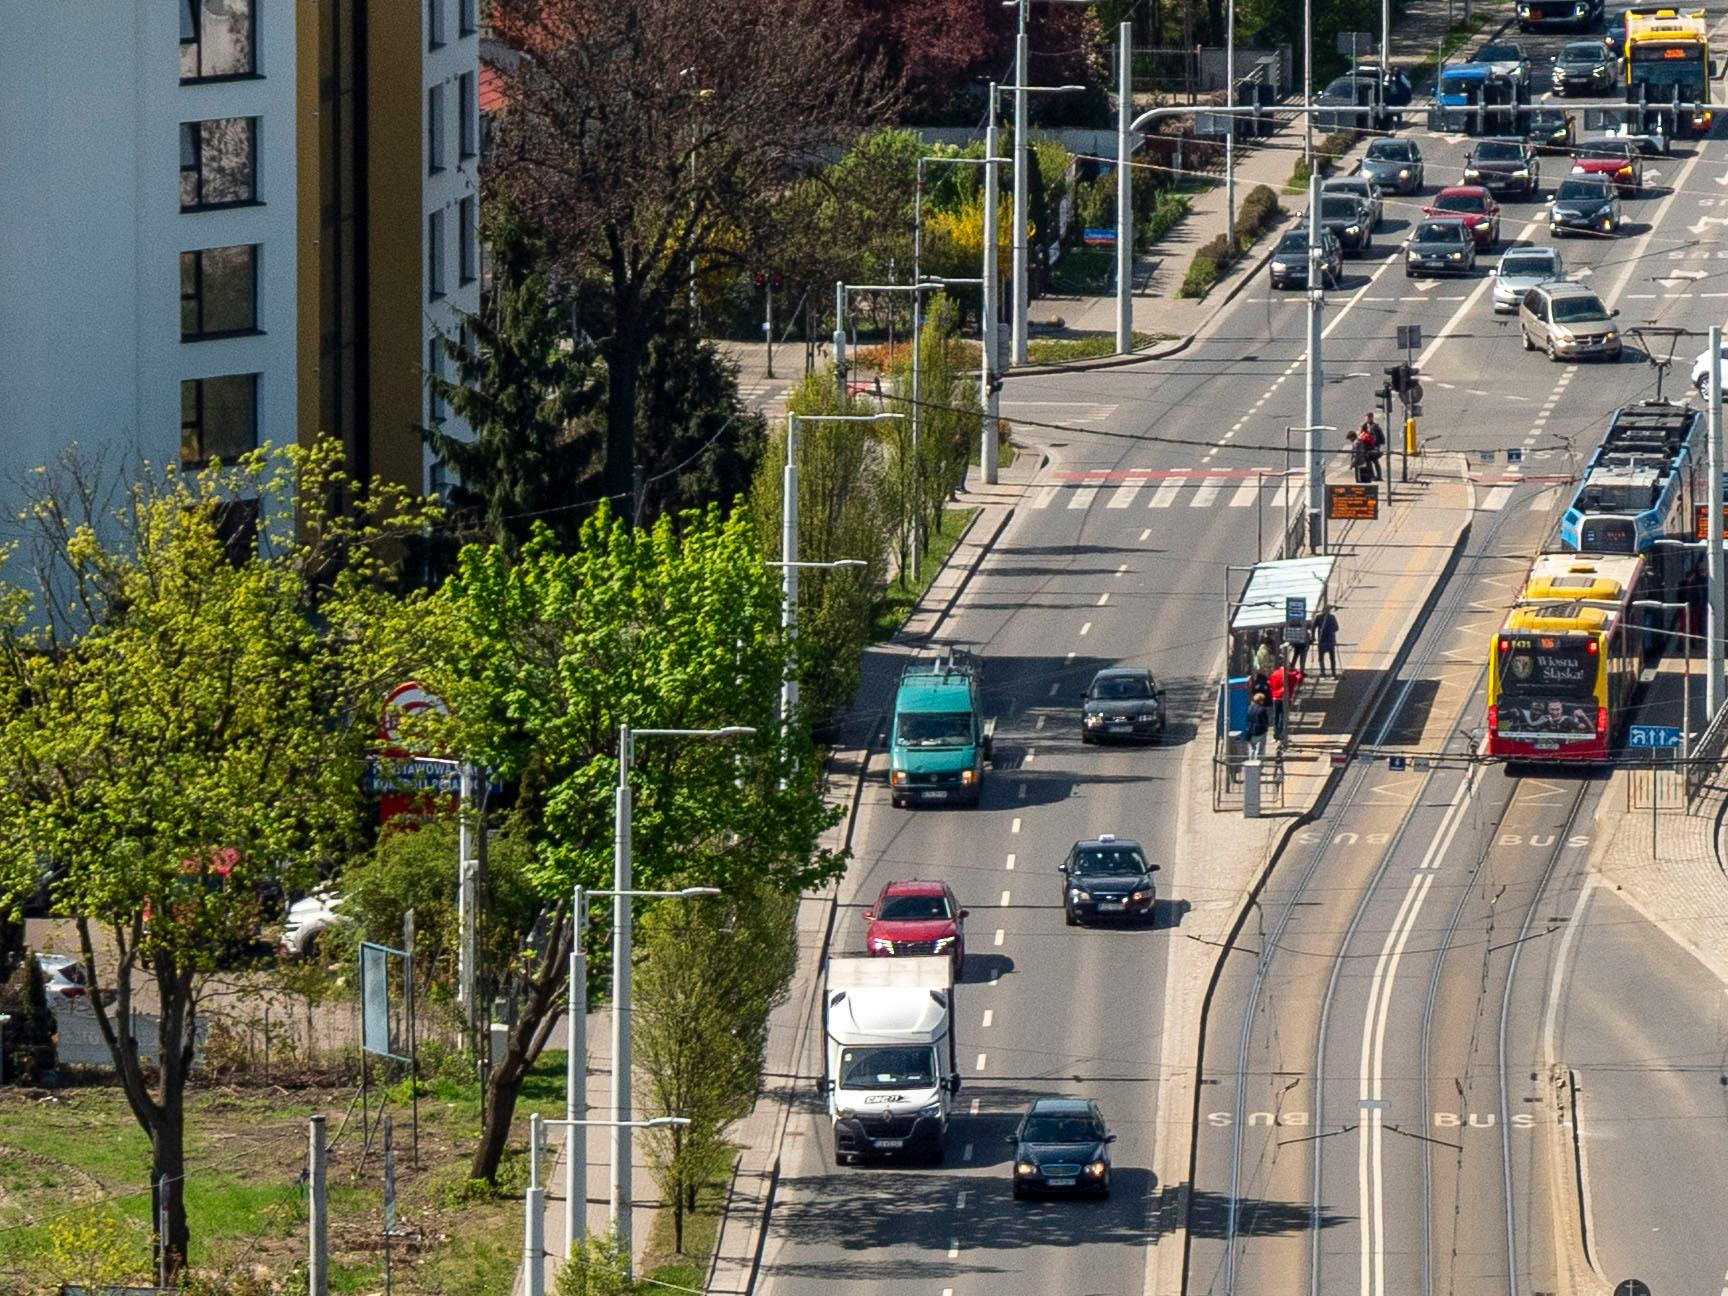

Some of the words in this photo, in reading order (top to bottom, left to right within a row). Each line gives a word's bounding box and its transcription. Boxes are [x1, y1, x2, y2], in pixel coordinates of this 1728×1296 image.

[1298, 831, 1391, 845] BUS
[1497, 834, 1591, 847] BUS
[1207, 1111, 1310, 1127] BUS
[1434, 1112, 1537, 1128] BUS
